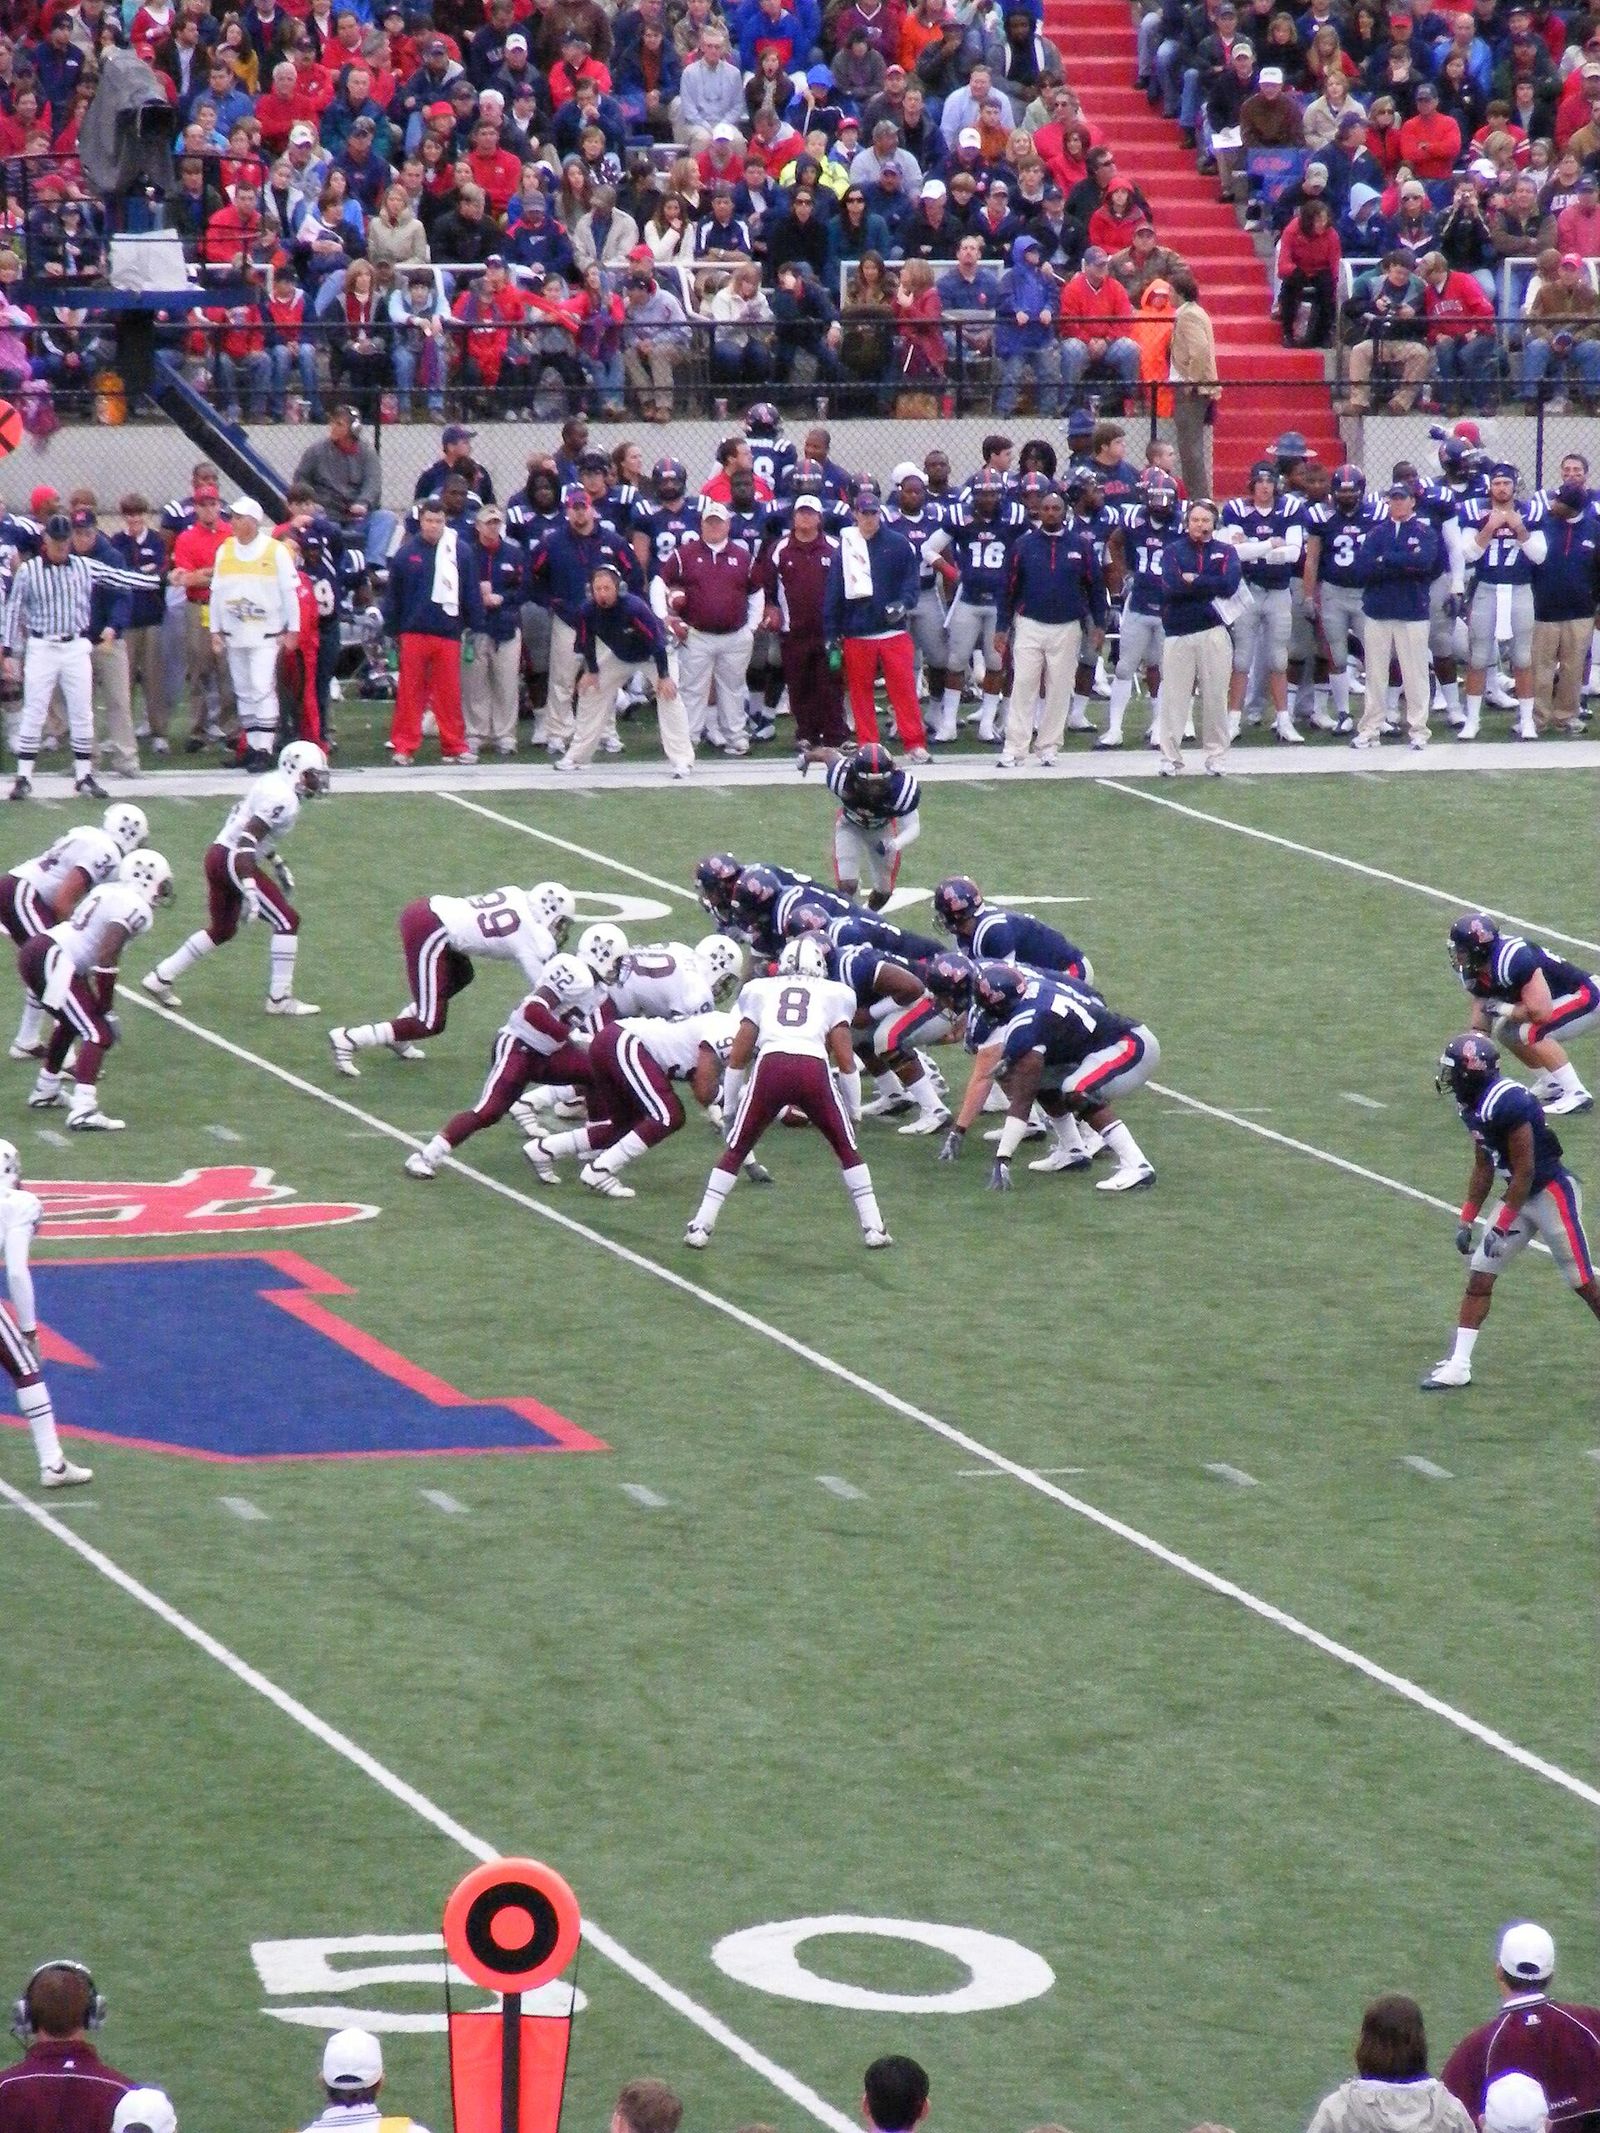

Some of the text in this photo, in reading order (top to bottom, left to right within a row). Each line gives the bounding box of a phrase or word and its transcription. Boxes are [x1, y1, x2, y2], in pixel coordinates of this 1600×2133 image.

[968, 541, 1006, 569] 16
[1488, 538, 1521, 567] 17
[550, 963, 575, 992] 52
[776, 986, 811, 1027] 8
